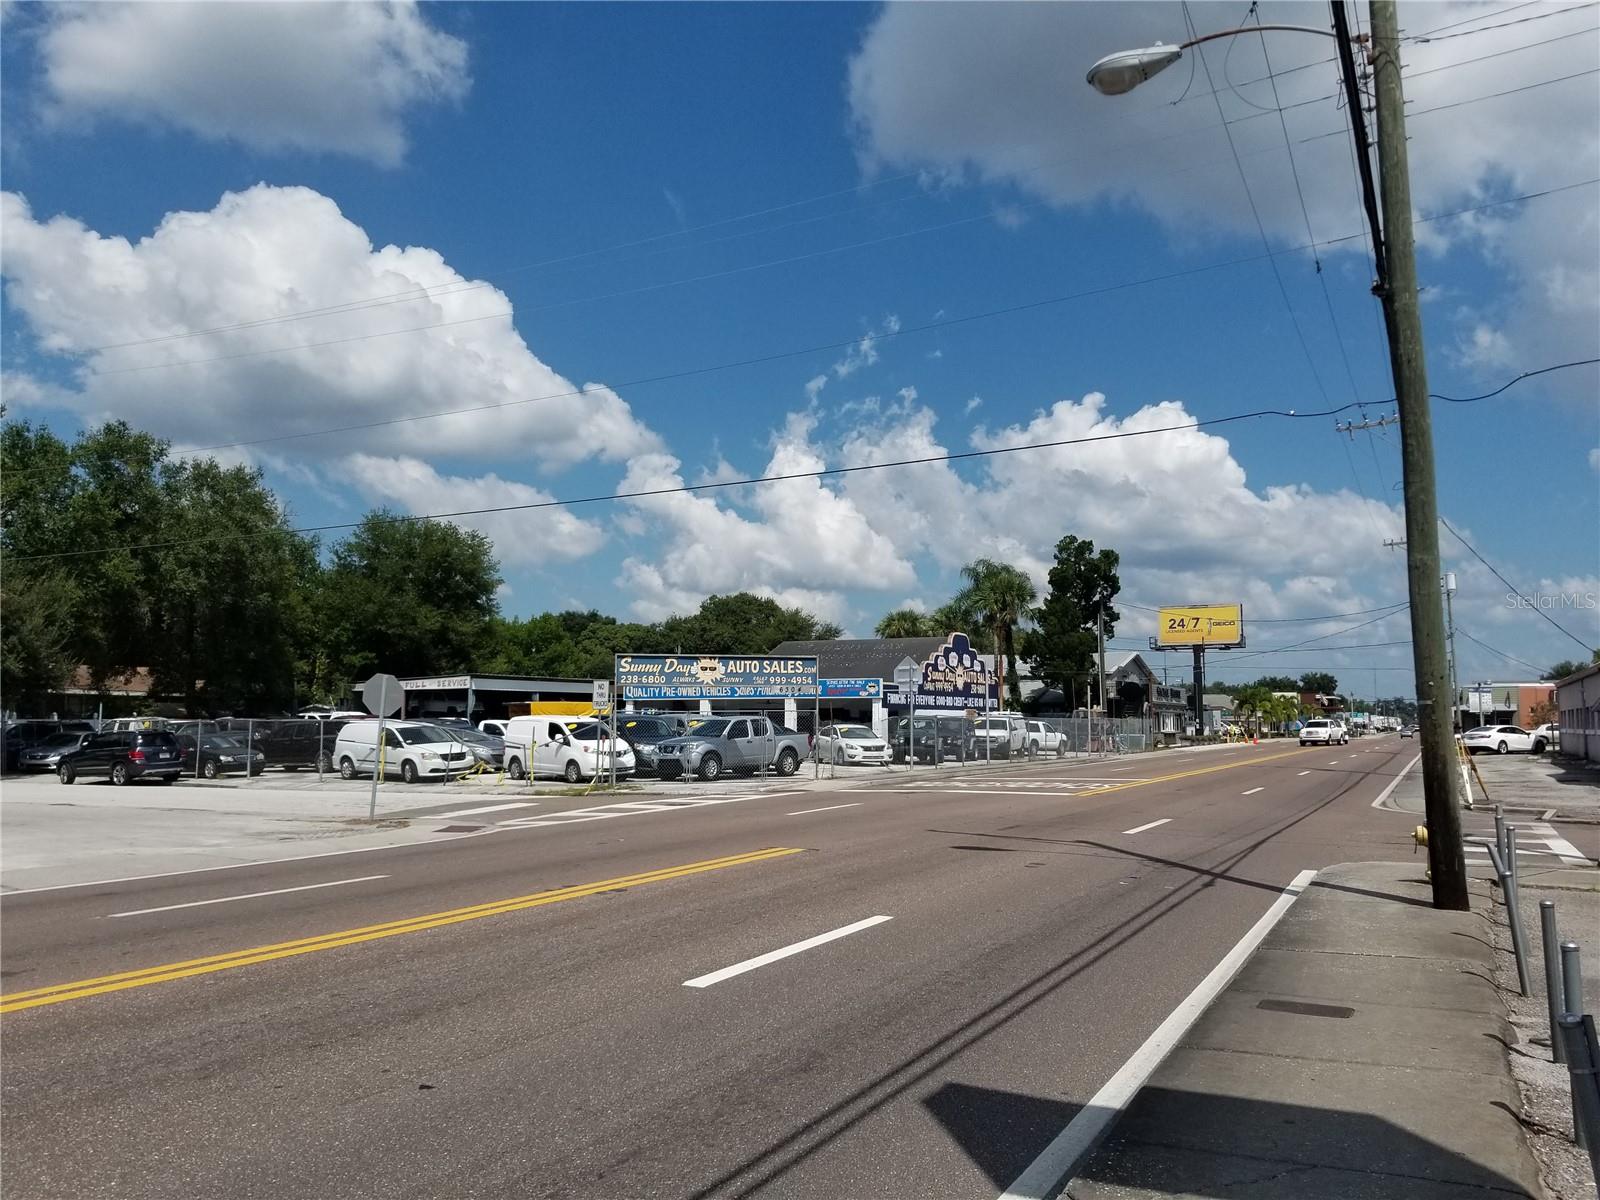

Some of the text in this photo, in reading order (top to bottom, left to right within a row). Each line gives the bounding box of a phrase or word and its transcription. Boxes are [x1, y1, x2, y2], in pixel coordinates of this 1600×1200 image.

[1168, 617, 1200, 629] 24/7
[619, 657, 662, 675] Sunny
[664, 658, 691, 676] Day
[727, 660, 759, 673] AUTO
[620, 675, 665, 683] 238-6800
[769, 676, 812, 684] 999-4954
[928, 666, 991, 684] Sunny Day AUTO SALS
[437, 678, 468, 687] SERVICE
[597, 681, 605, 690] NO
[596, 691, 606, 699] THRU
[626, 686, 660, 698] QUALITY
[661, 686, 701, 697] PRE-OWNED
[702, 686, 731, 697] VEHICLES
[887, 693, 906, 704] FINANCING
[907, 694, 915, 705] FR
[916, 695, 935, 706] EVERYONE
